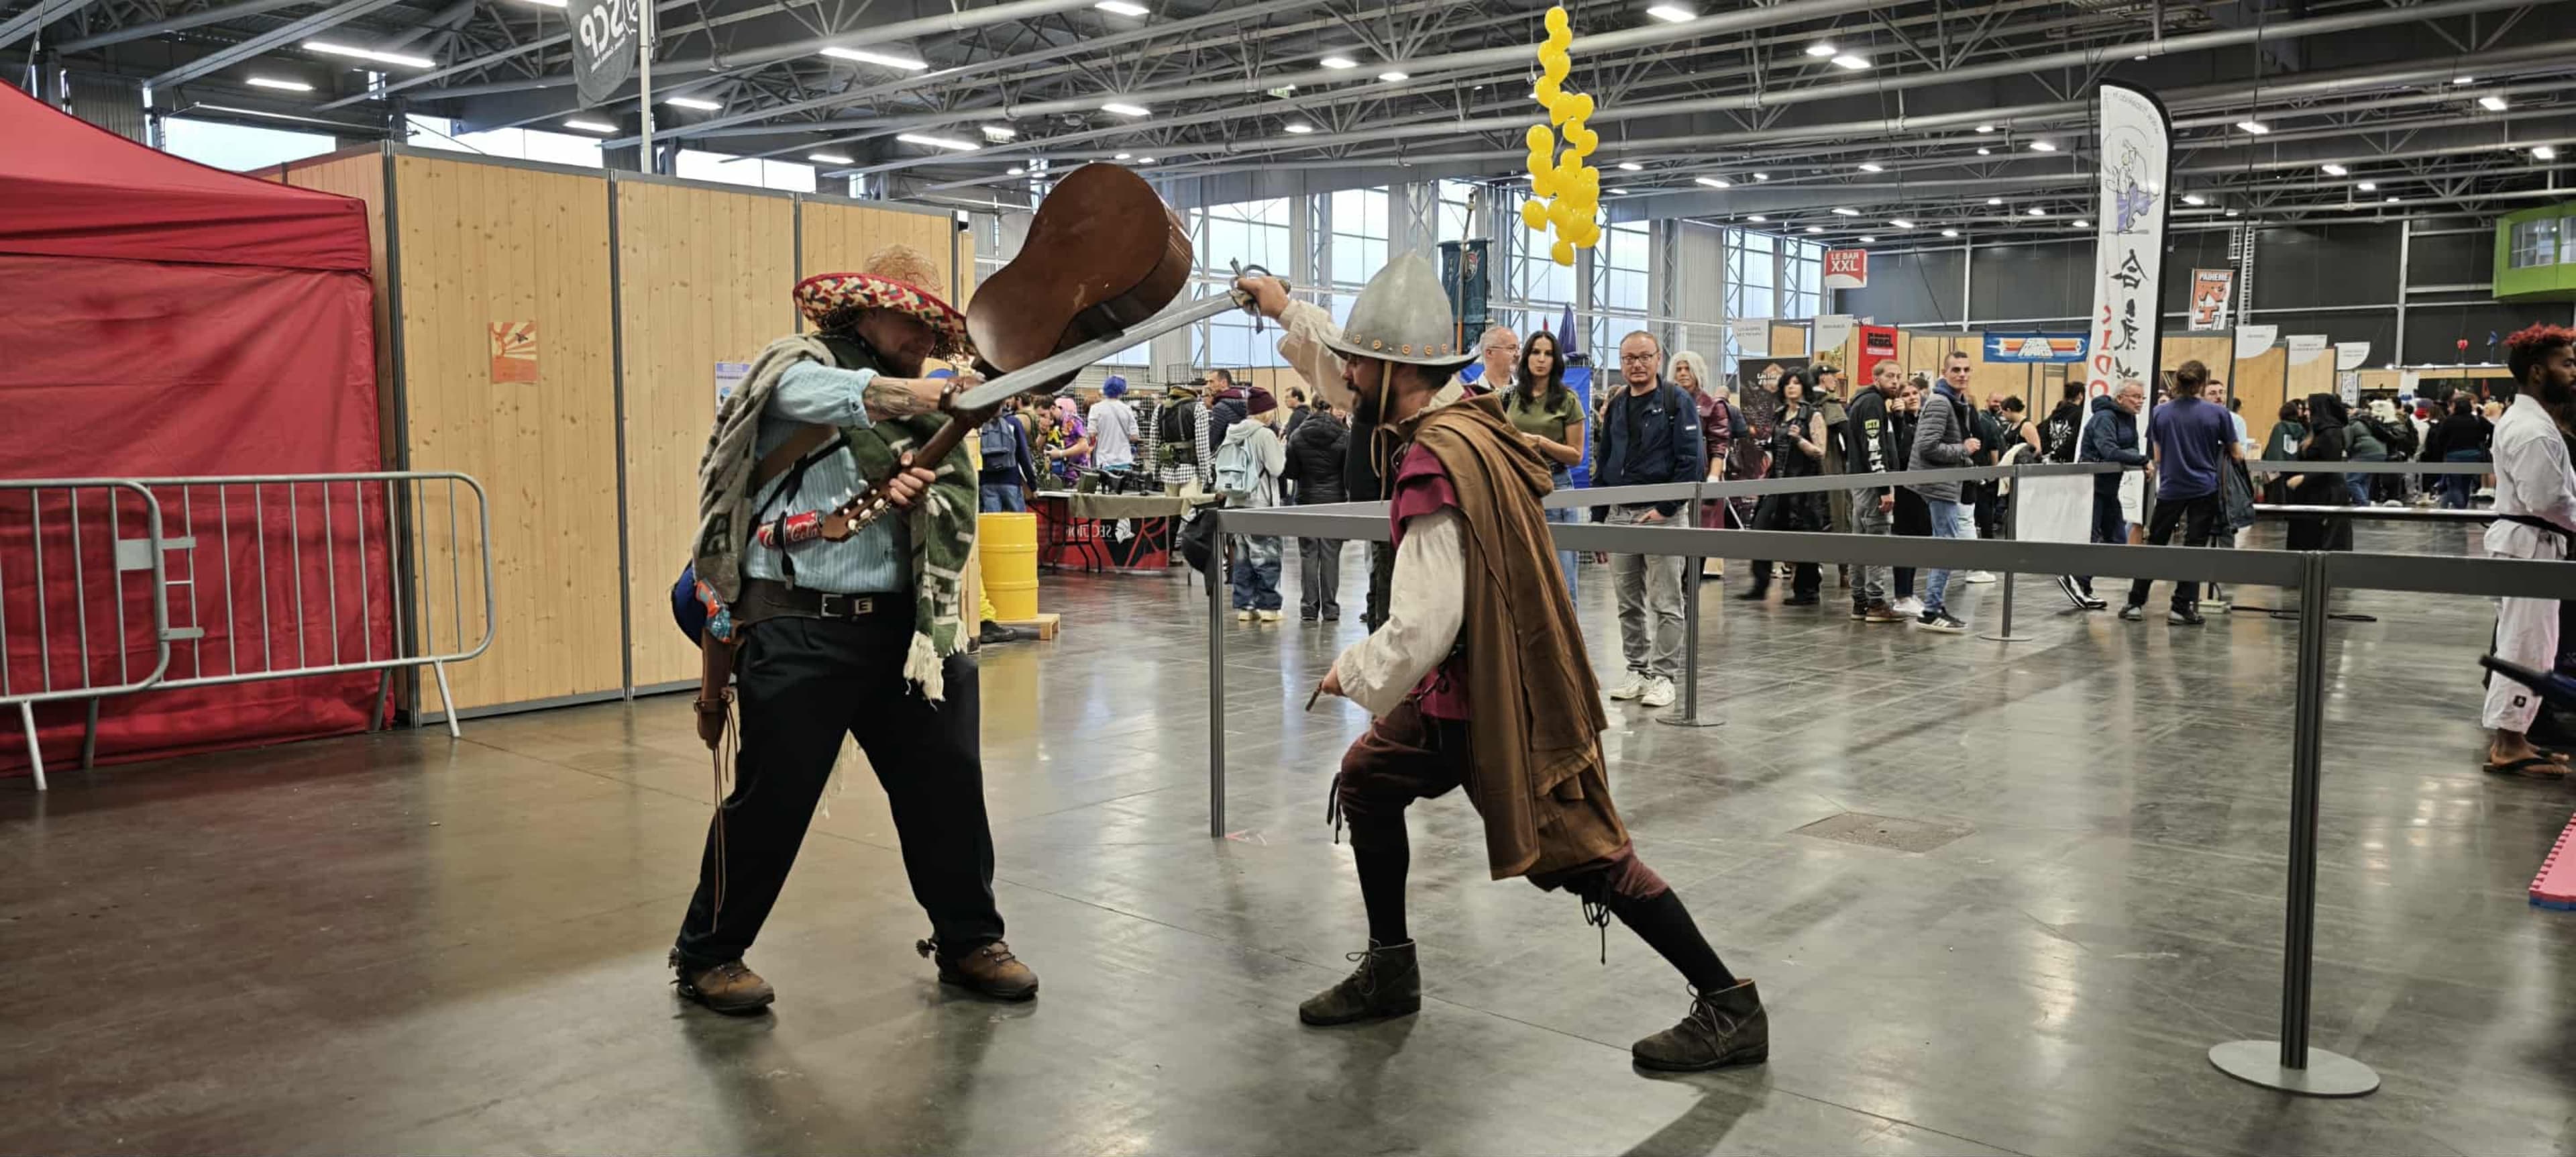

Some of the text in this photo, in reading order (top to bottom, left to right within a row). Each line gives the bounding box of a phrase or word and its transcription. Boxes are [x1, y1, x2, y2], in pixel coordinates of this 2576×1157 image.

[1831, 251, 1859, 260] LE BAR
[1831, 259, 1859, 272] XXL
